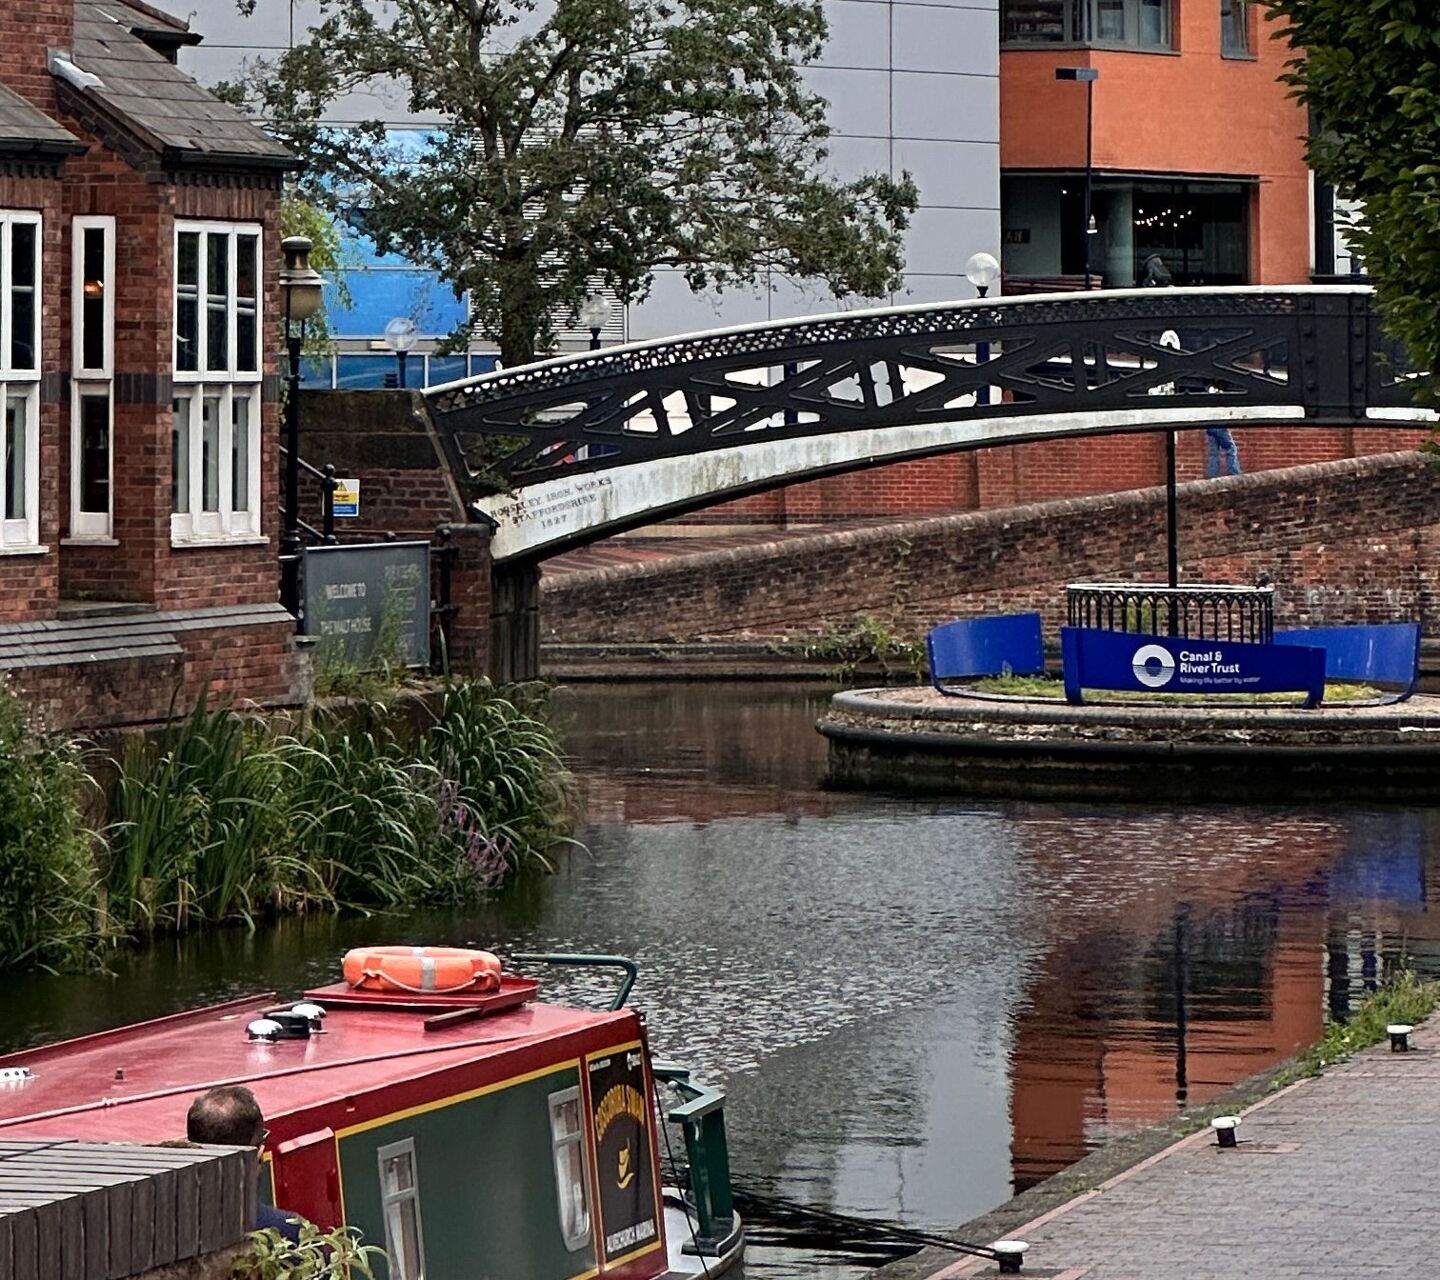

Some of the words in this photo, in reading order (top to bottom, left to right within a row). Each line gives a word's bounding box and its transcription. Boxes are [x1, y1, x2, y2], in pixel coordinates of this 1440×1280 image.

[1179, 651, 1213, 662] Canal
[1214, 651, 1222, 661] &
[1180, 663, 1209, 673] River
[1211, 662, 1240, 673] Trust
